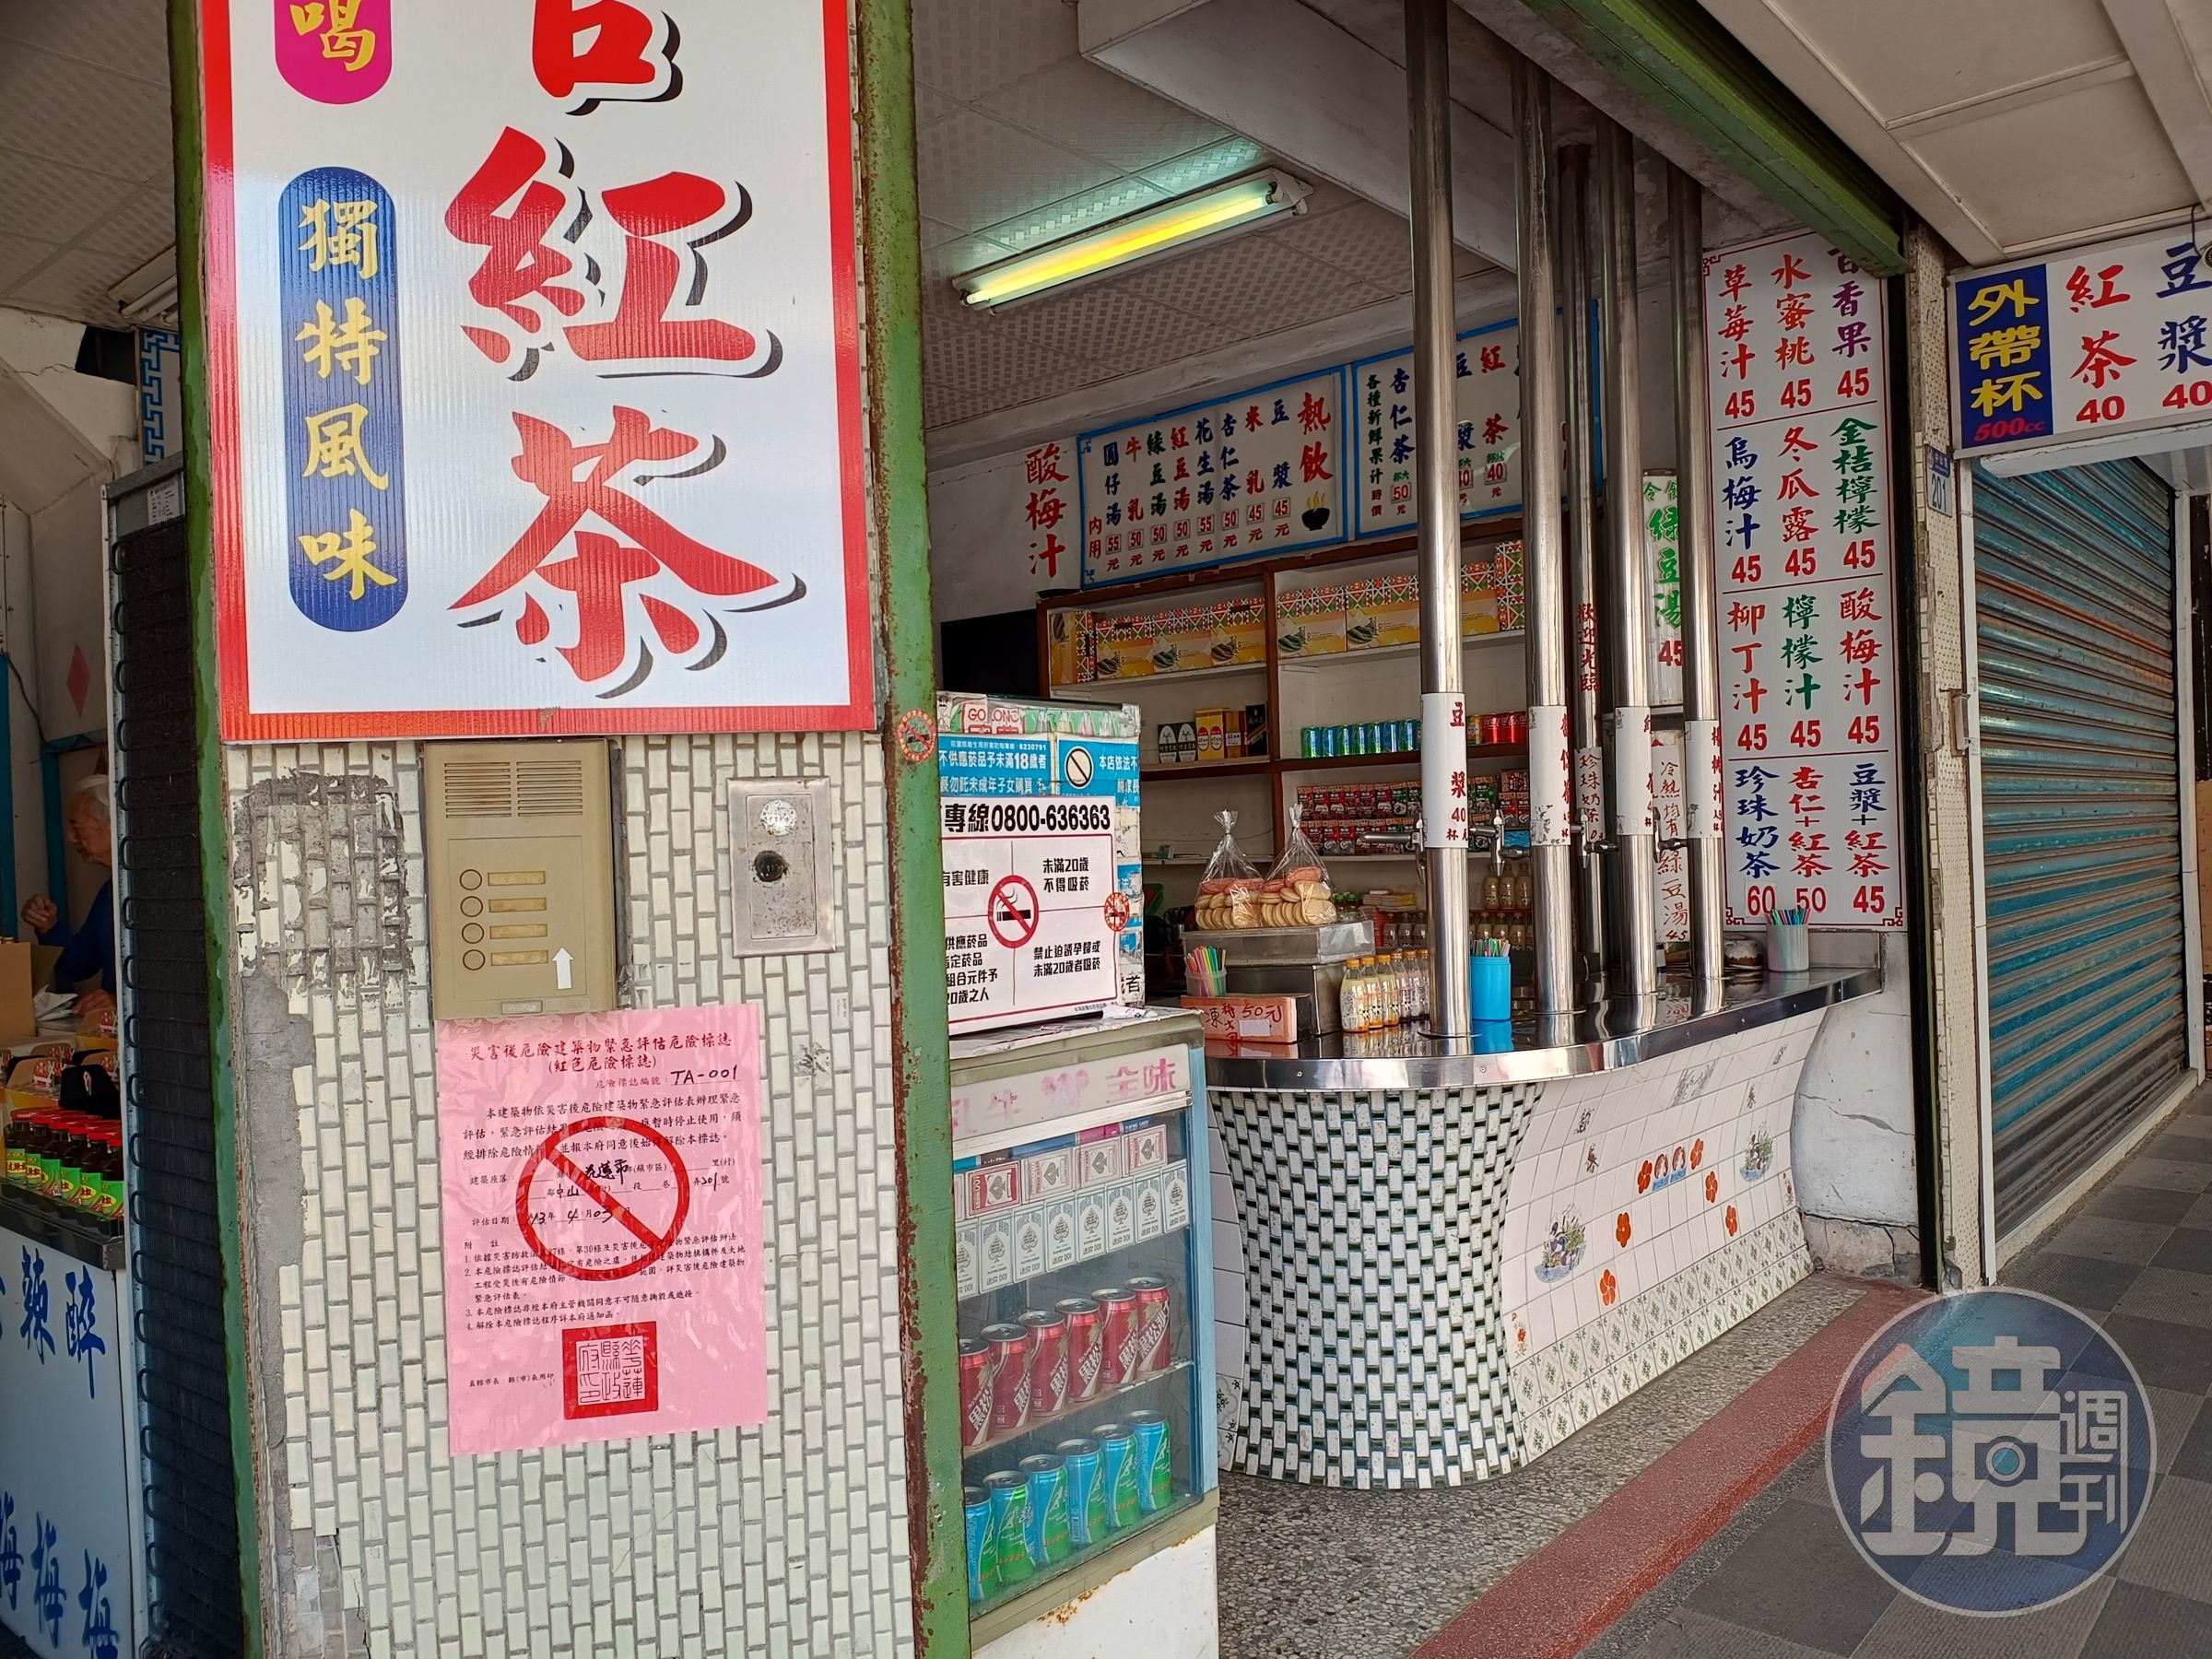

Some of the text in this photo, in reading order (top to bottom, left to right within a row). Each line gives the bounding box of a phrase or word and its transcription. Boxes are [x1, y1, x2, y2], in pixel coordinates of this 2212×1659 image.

[1718, 265, 1756, 419] 草莓汁 45
[1771, 253, 1815, 408] 水蜜桃 45
[1968, 278, 2043, 418] 外帶杯
[2065, 265, 2137, 423] 紅茶 40
[295, 198, 397, 601] 獨特風味
[1390, 368, 1415, 464] 杏仁茶
[1480, 346, 1509, 444] 紅茶
[1837, 368, 1870, 398] 45
[2162, 381, 2212, 409] 40
[1194, 418, 1215, 553] 花生湯 55 元
[1220, 413, 1241, 548] 杏仁茶 50 元
[1245, 406, 1265, 543] 米乳 45 元
[1271, 399, 1292, 537] 豆漿 45 元
[1298, 392, 1334, 483] 熱飲
[1488, 463, 1503, 480] 40
[1025, 443, 1069, 578] 酸梅汁
[1125, 437, 1144, 567] 牛乳 50 元
[1153, 527, 1164, 542] 50
[1171, 427, 1190, 559] 紅豆湯 50 元
[1394, 485, 1408, 499] 50
[1722, 436, 1762, 583] 烏梅汁 45
[1776, 426, 1820, 577] 冬瓜露 45
[1830, 418, 1881, 570] 金桔檸檬 45
[1931, 473, 1947, 513] 201
[1107, 559, 1120, 571] 元
[1108, 536, 1119, 551] 55
[1152, 549, 1165, 562] 元
[1577, 603, 1599, 692] 歡迎光臨
[1727, 601, 1768, 751] 柳丁汁 45
[1781, 594, 1822, 748] 檸檬汁 45
[1839, 586, 1883, 745] 酸梅汁 45
[968, 709, 986, 720] GO
[1451, 806, 1466, 823] 40
[1735, 766, 1781, 916] 珍珠奶茶 60
[1042, 857, 1089, 874] 未滿20歲
[1043, 877, 1089, 892] 不得吸菸
[1796, 887, 1827, 913] 50
[1853, 885, 1885, 913] 45
[1033, 958, 1100, 977] 未滿20歲者吸菸
[670, 1065, 738, 1086] TA-001
